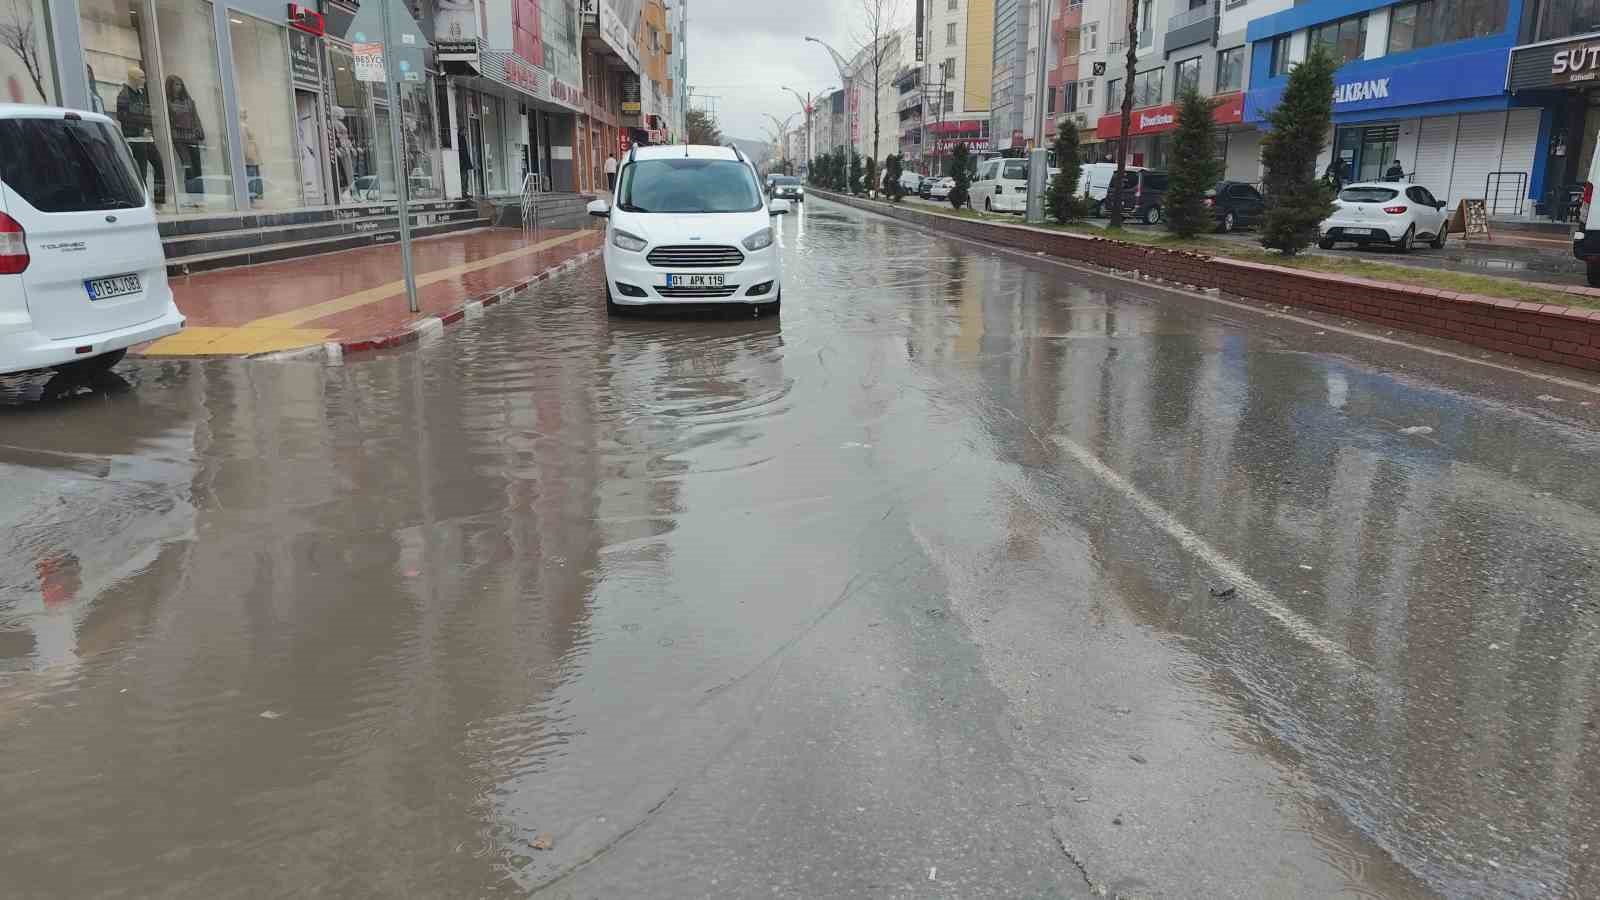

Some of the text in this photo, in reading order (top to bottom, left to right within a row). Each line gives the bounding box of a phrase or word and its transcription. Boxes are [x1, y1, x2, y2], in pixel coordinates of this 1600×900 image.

[1332, 78, 1389, 103] ALKBANK
[672, 275, 683, 285] 01
[708, 275, 723, 285] 119
